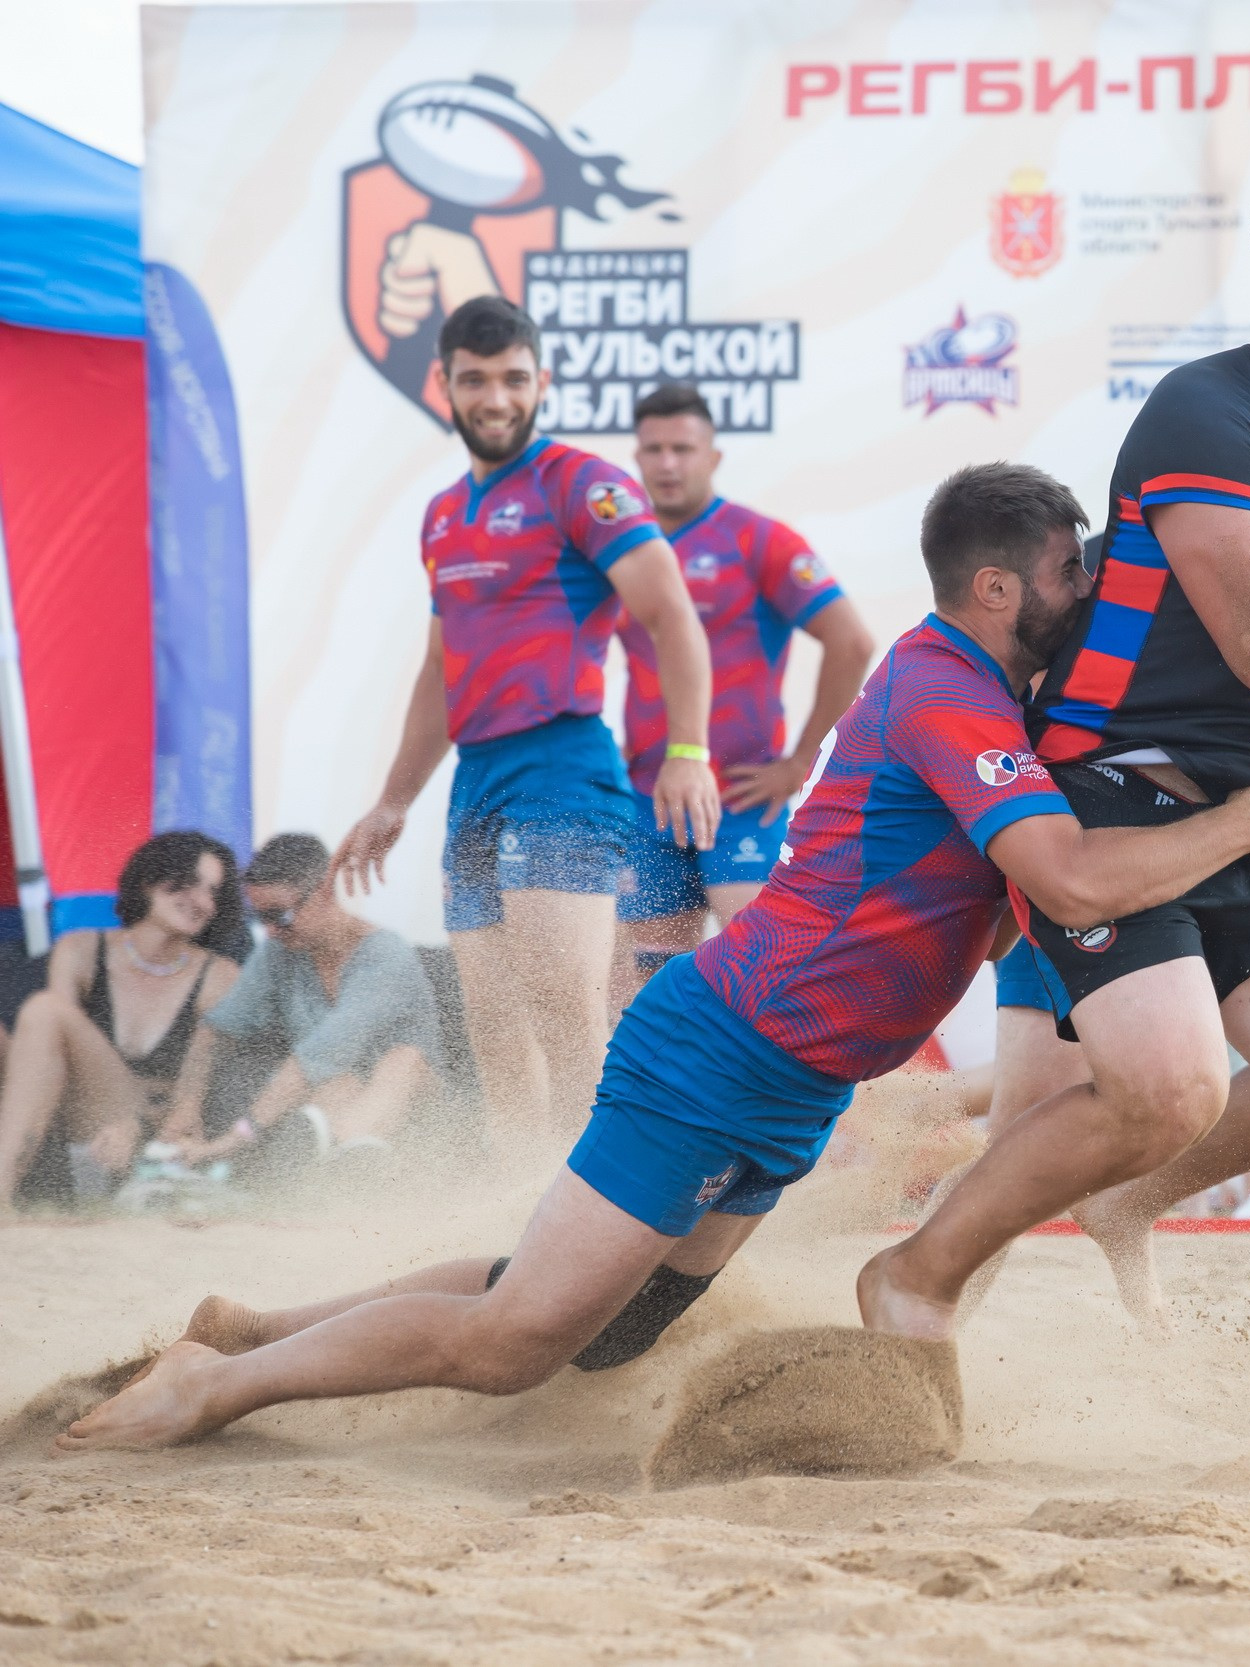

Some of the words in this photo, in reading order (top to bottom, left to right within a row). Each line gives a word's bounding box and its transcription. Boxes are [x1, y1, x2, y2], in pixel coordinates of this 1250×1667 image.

[528, 255, 684, 277] ФЕДЕРАЦИЯ
[528, 279, 684, 327] РЕГБИ
[540, 320, 795, 378] ТУЛЬСКОЙ
[537, 381, 769, 431] ОБЛТИ
